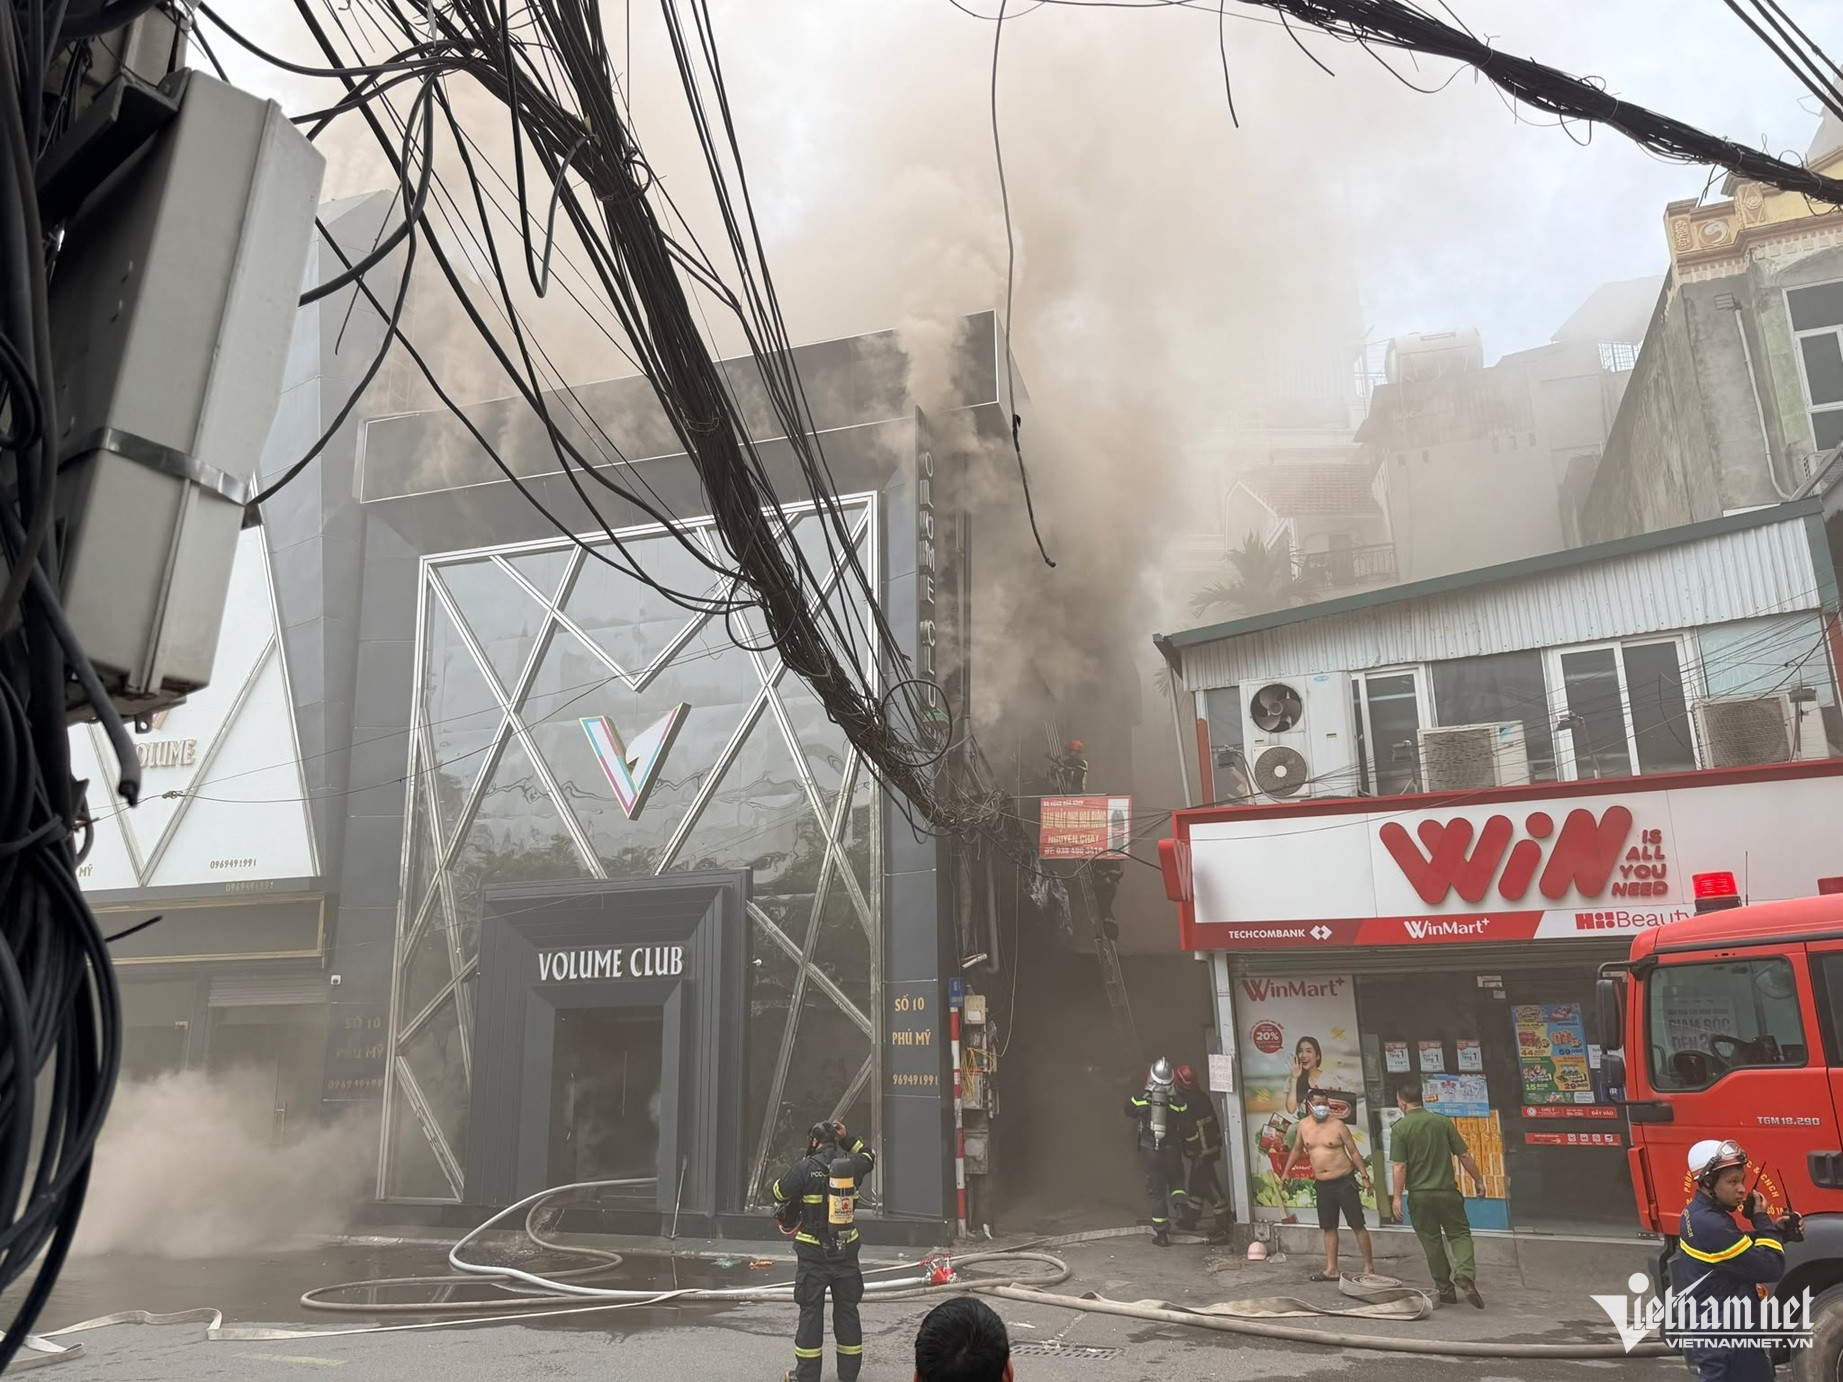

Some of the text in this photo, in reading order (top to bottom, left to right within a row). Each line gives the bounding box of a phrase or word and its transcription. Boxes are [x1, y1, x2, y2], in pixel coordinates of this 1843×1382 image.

[1641, 829, 1662, 844] IS
[1625, 845, 1665, 860] ALL
[210, 858, 257, 869] 0969491991
[1619, 863, 1666, 879] YOU
[1611, 881, 1668, 897] NEED
[1228, 929, 1306, 939] TECHCOMBANK
[538, 946, 684, 981] VOLUME CLUB
[894, 994, 925, 1012] SỐ 10
[892, 1028, 932, 1045] PHÚ MỸ
[1256, 1032, 1279, 1041] 20%
[1760, 1174, 1780, 1198] CNCH
